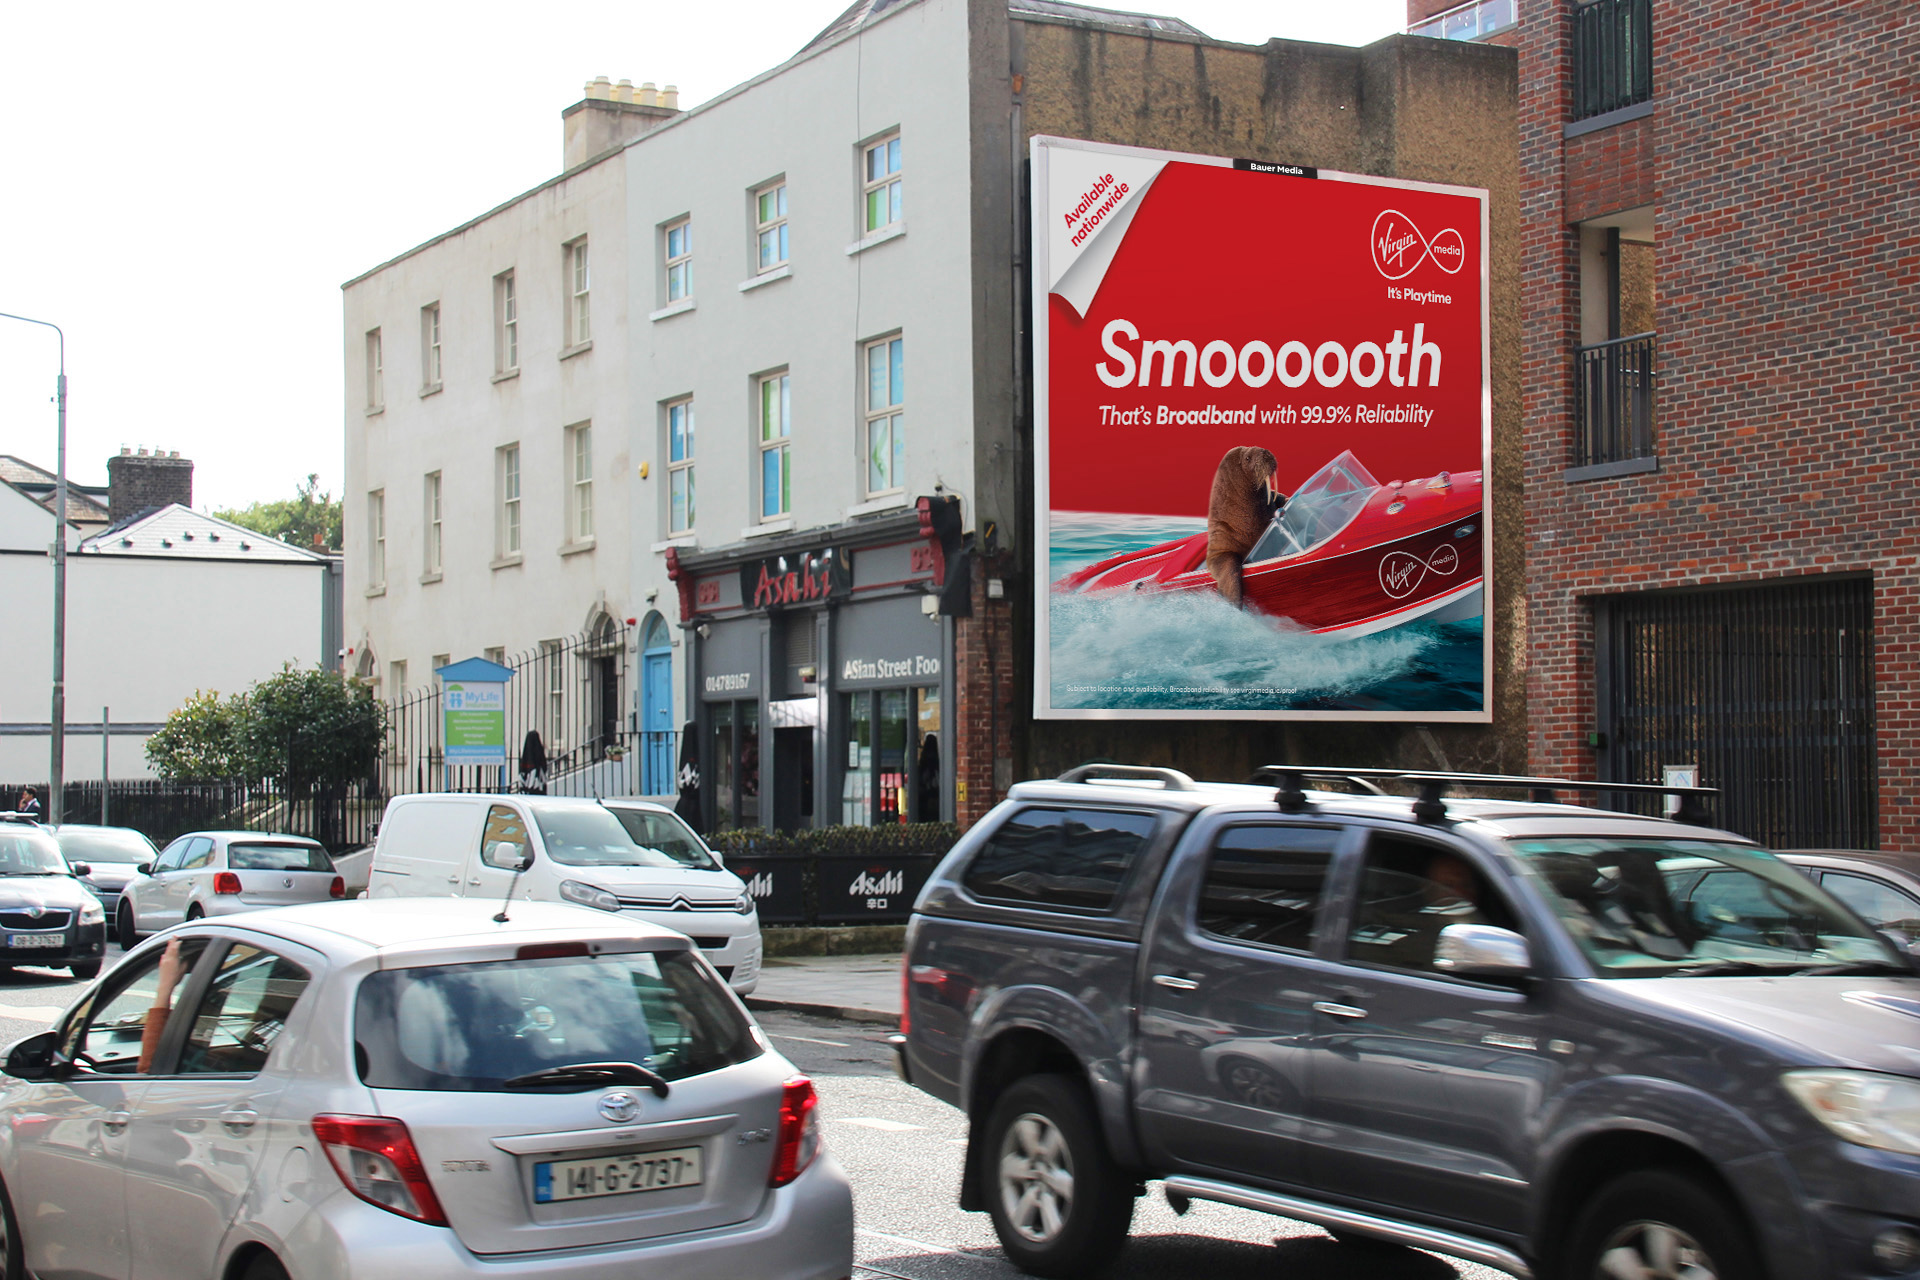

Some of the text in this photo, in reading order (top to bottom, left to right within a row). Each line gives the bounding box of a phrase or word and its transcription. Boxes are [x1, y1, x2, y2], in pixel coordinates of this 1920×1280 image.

[1250, 163, 1303, 175] Bauer Media
[1064, 173, 1114, 229] Available
[1071, 183, 1129, 247] nationwide
[1378, 222, 1461, 268] Virgin media
[1387, 286, 1452, 305] It's Playtime
[1095, 318, 1442, 389] Smoooooth
[1099, 404, 1434, 427] That's Broadband with 99.9% Reliability
[754, 554, 832, 607] Asahi
[1386, 554, 1455, 590] Virgin media
[877, 658, 912, 678] Street
[915, 655, 940, 676] Foo
[705, 672, 751, 692] 014789167
[465, 692, 499, 703] MyLife
[748, 872, 772, 897] ahi
[849, 870, 903, 895] Asahi
[867, 899, 887, 909] 辛口
[567, 1156, 684, 1195] 141-G-2737
